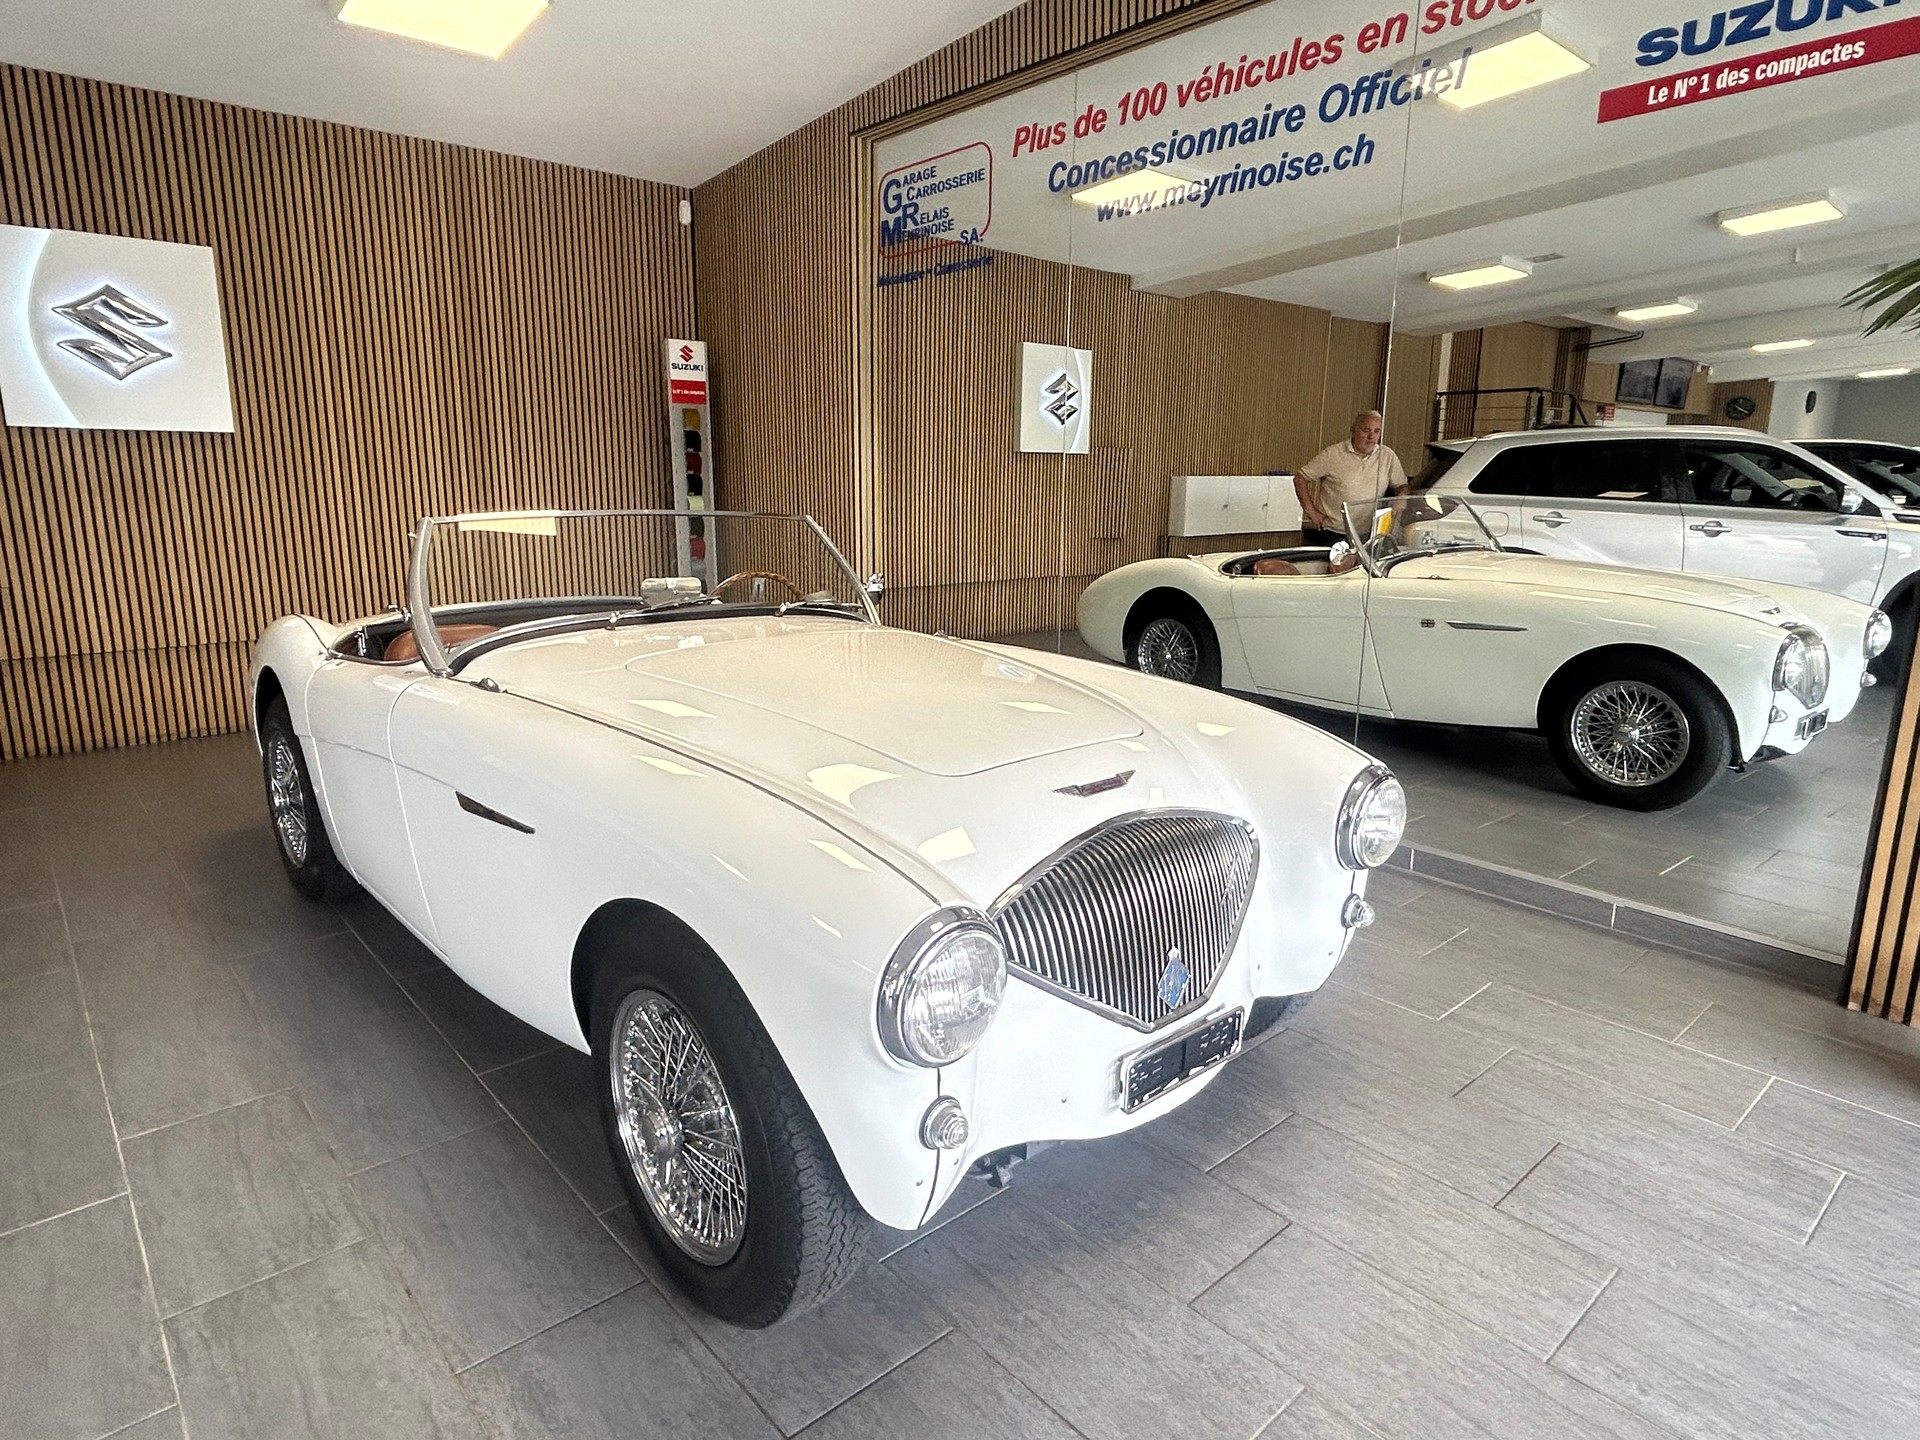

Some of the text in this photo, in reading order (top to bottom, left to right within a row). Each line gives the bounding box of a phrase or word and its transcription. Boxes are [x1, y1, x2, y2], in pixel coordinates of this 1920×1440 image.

[1012, 0, 1535, 157] Plus de 100 véhicules en sto
[1647, 85, 1669, 105] Le
[1716, 67, 1750, 90] des
[1755, 40, 1866, 80] compactes
[1048, 47, 1473, 193] Concessionnaire Officiel
[882, 165, 938, 214] GARAGE
[906, 168, 986, 202] CARROSSERIE
[1097, 133, 1375, 222] www.meyrinoise.ch
[902, 202, 950, 230] RELAIS
[671, 362, 704, 371] SUZUKI
